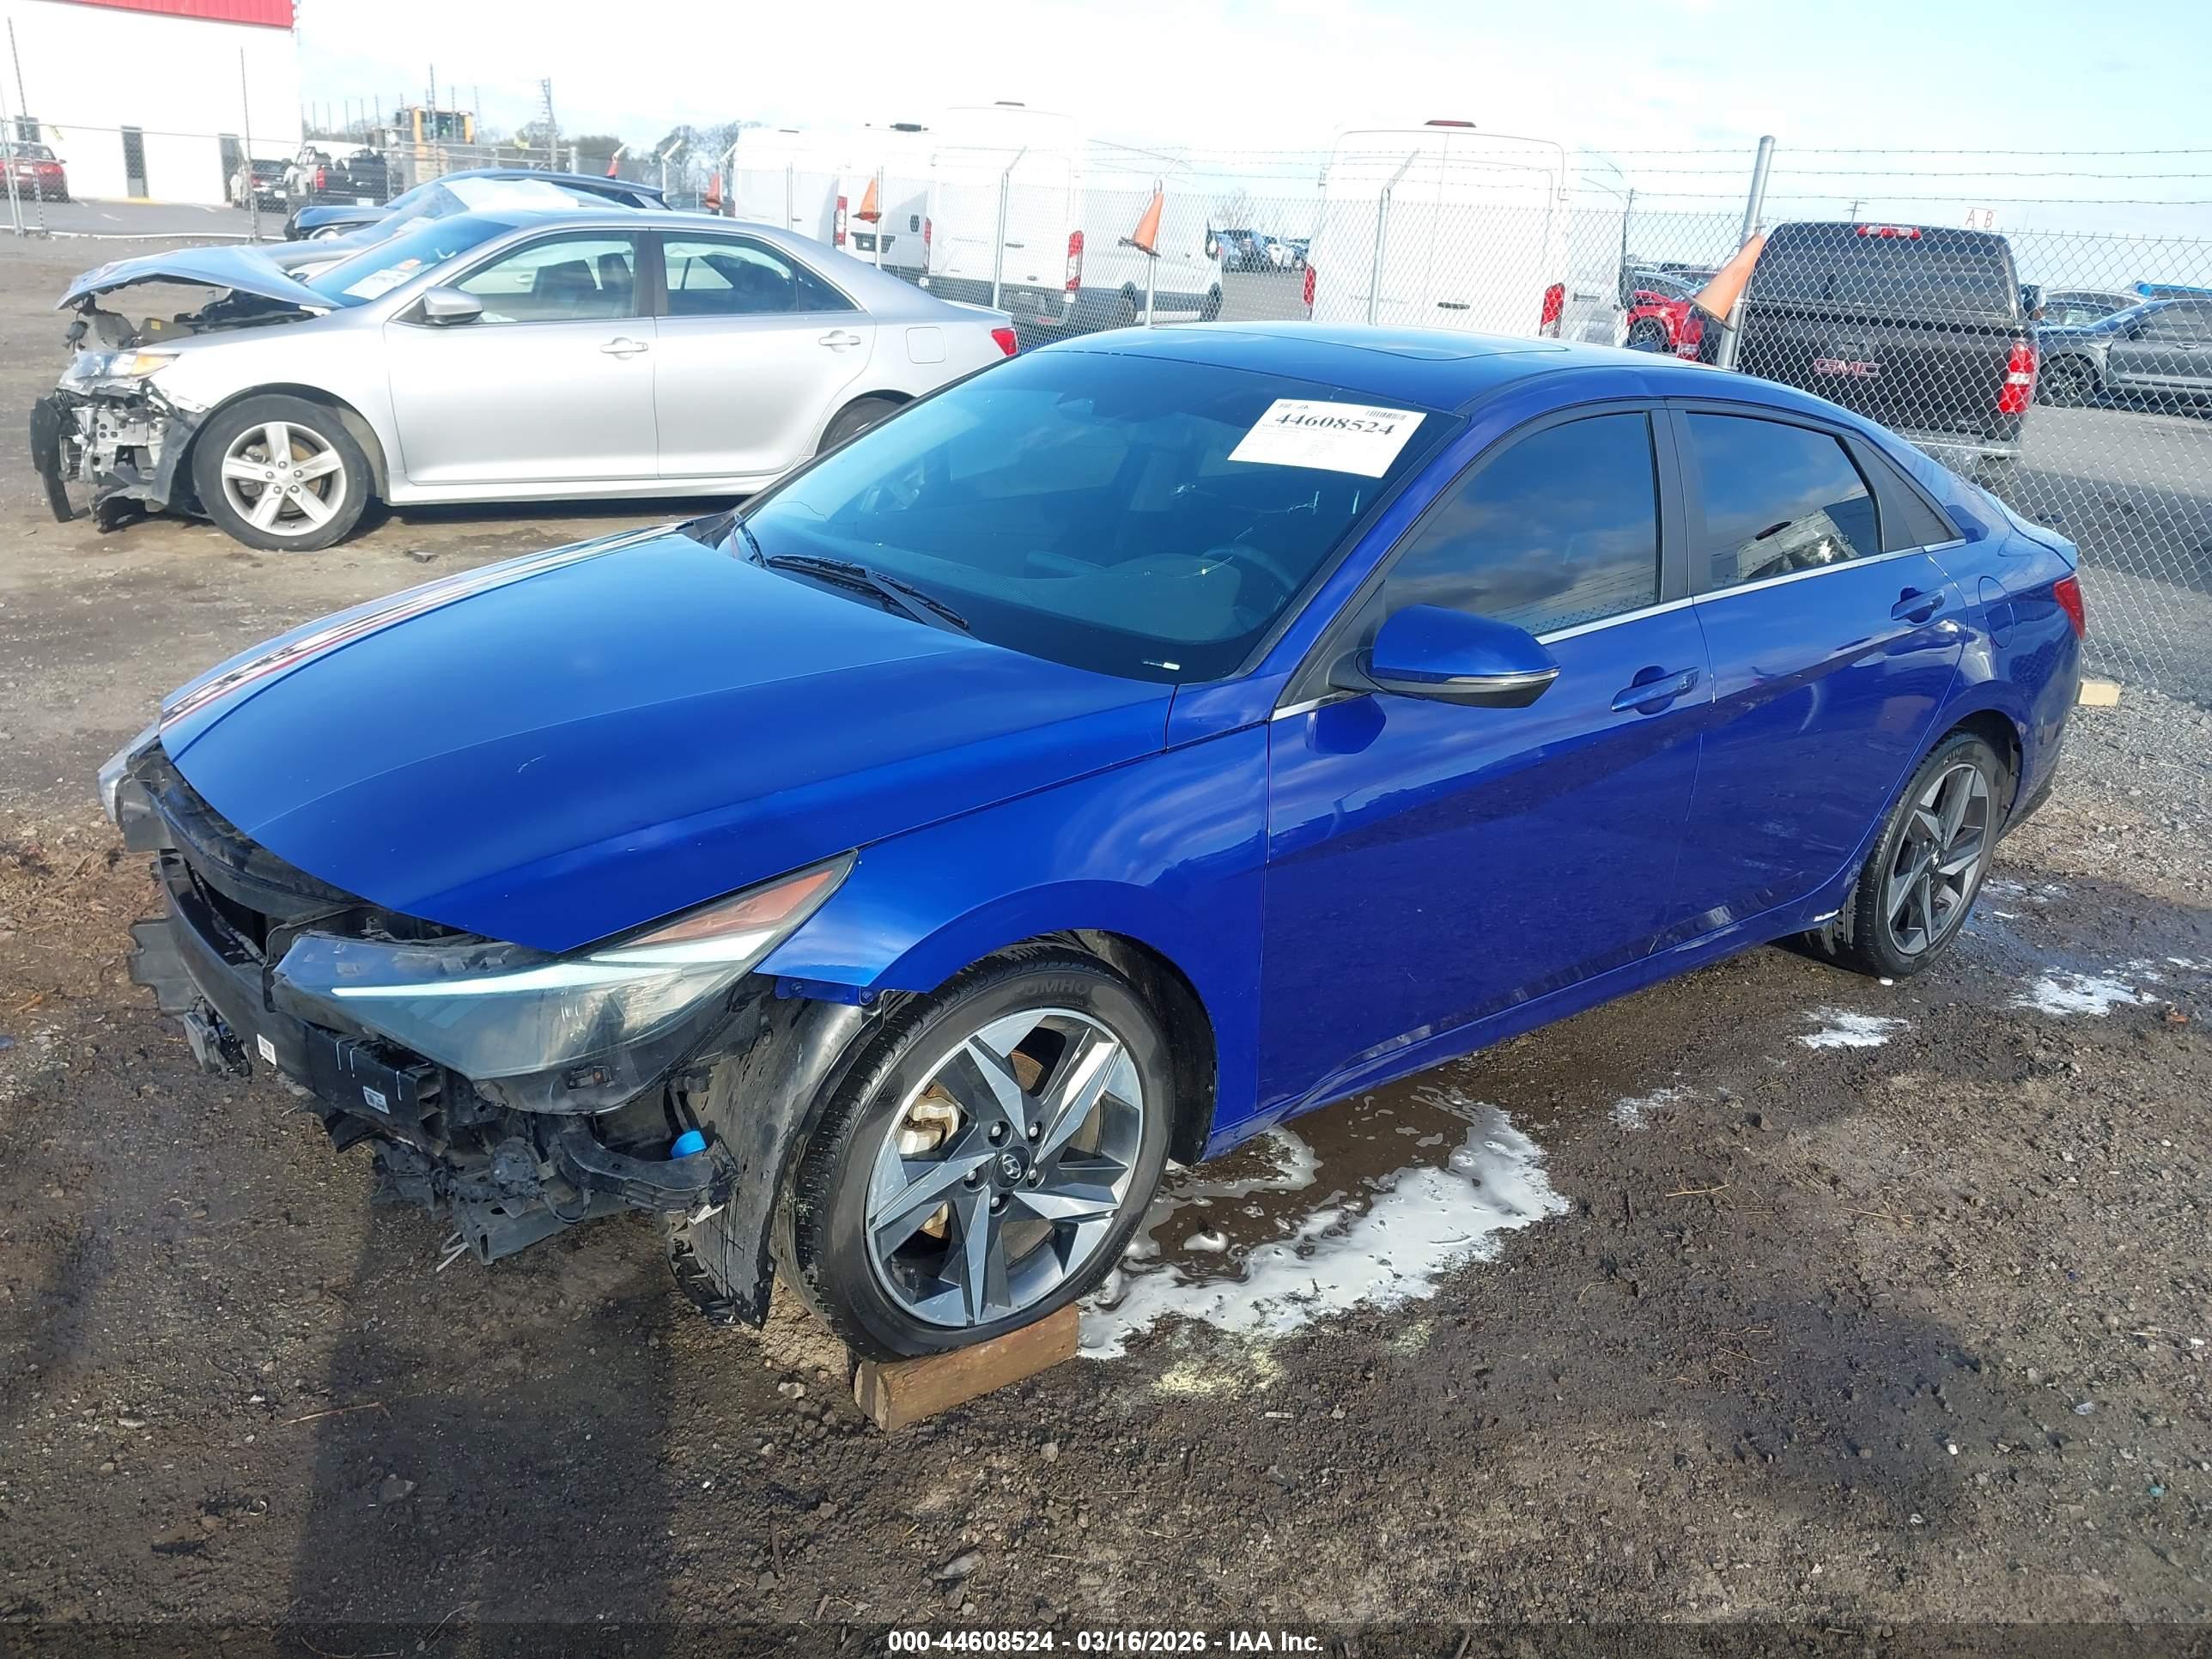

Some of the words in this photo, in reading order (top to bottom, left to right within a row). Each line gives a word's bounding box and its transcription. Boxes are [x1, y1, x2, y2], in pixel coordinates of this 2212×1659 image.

[1965, 209, 1975, 228] A
[1984, 211, 1994, 228] B
[1813, 358, 1881, 378] GMC
[1276, 413, 1395, 436] 44608524
